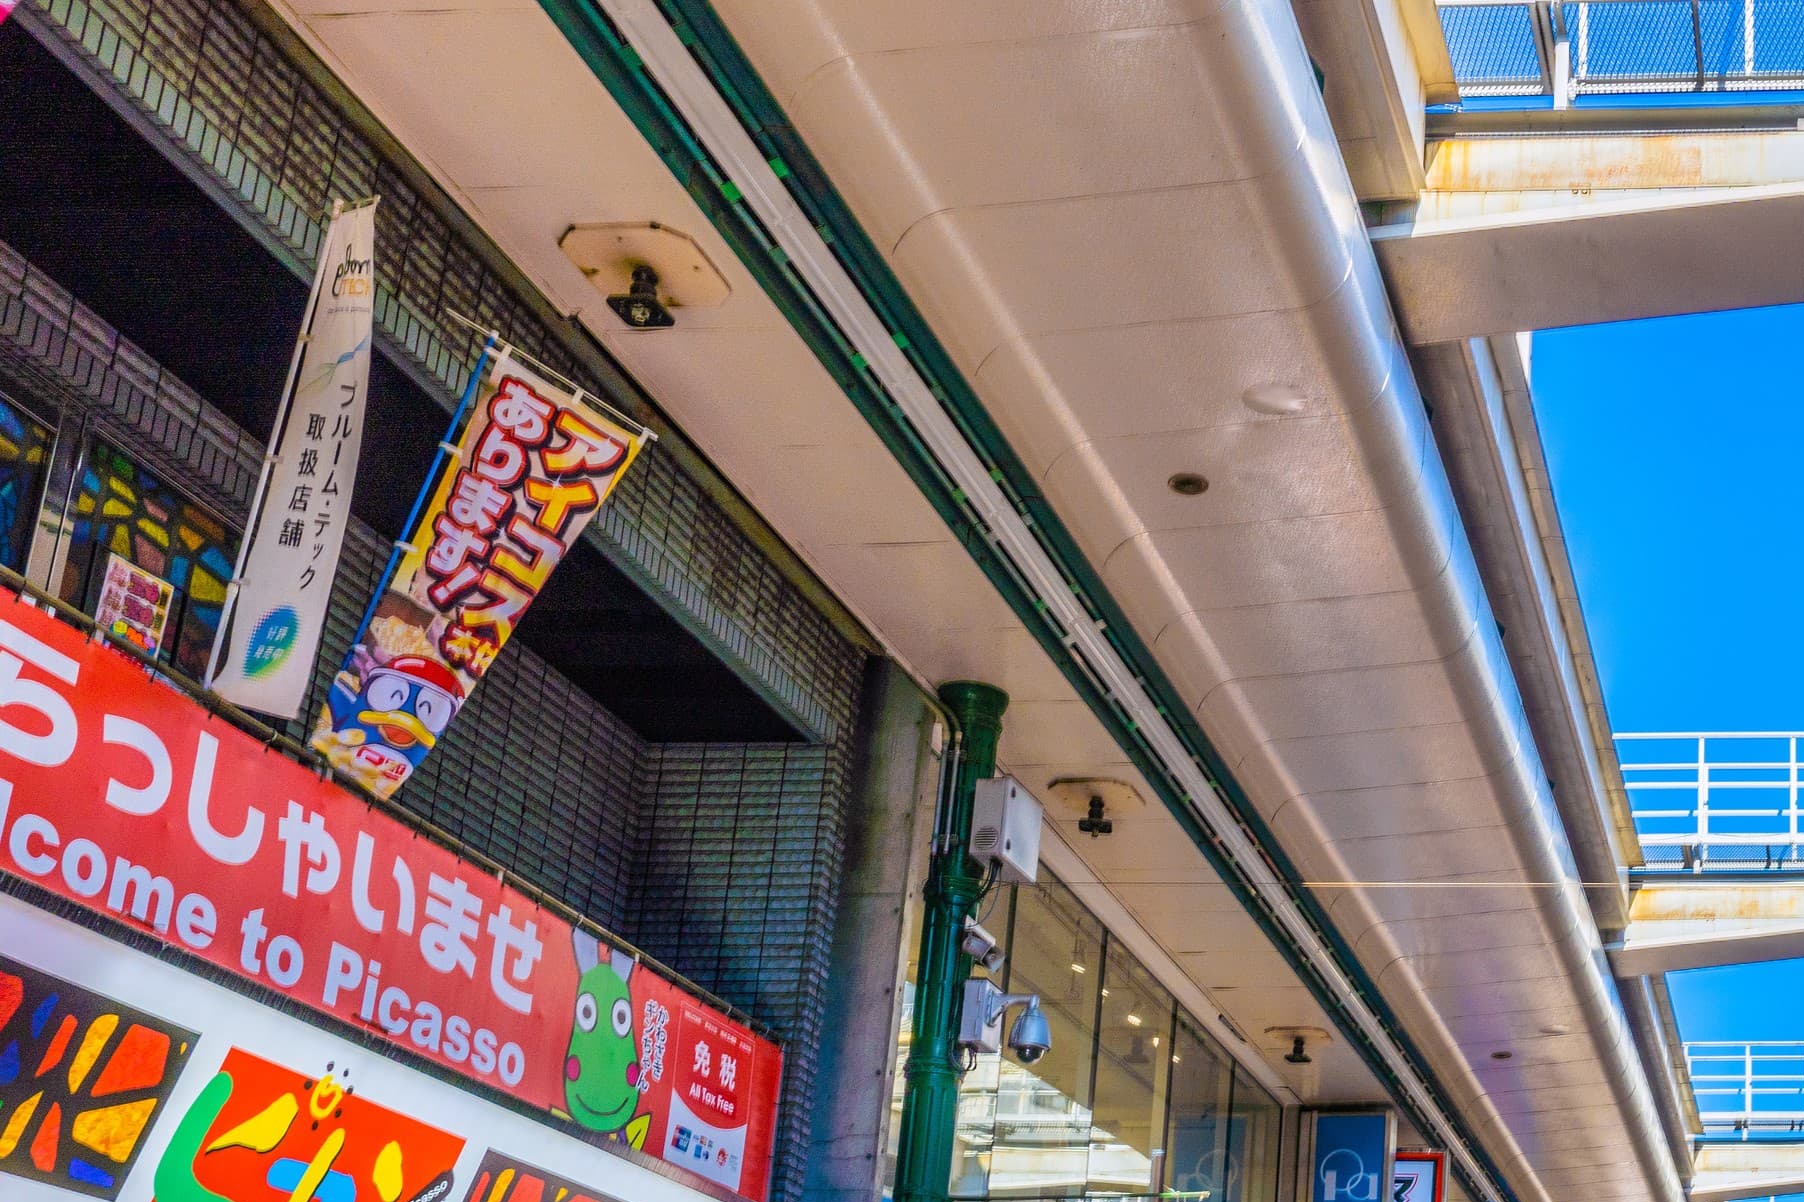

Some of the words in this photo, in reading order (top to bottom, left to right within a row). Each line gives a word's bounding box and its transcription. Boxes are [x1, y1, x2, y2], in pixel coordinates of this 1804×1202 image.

[276, 411, 326, 549] 取扱店舗
[466, 408, 628, 648] アイコス
[240, 911, 304, 984] to
[322, 940, 527, 1087] Picasso
[692, 1039, 738, 1093] 免税
[688, 1081, 702, 1099] All
[702, 1086, 716, 1106] Tax
[716, 1092, 735, 1114] Free
